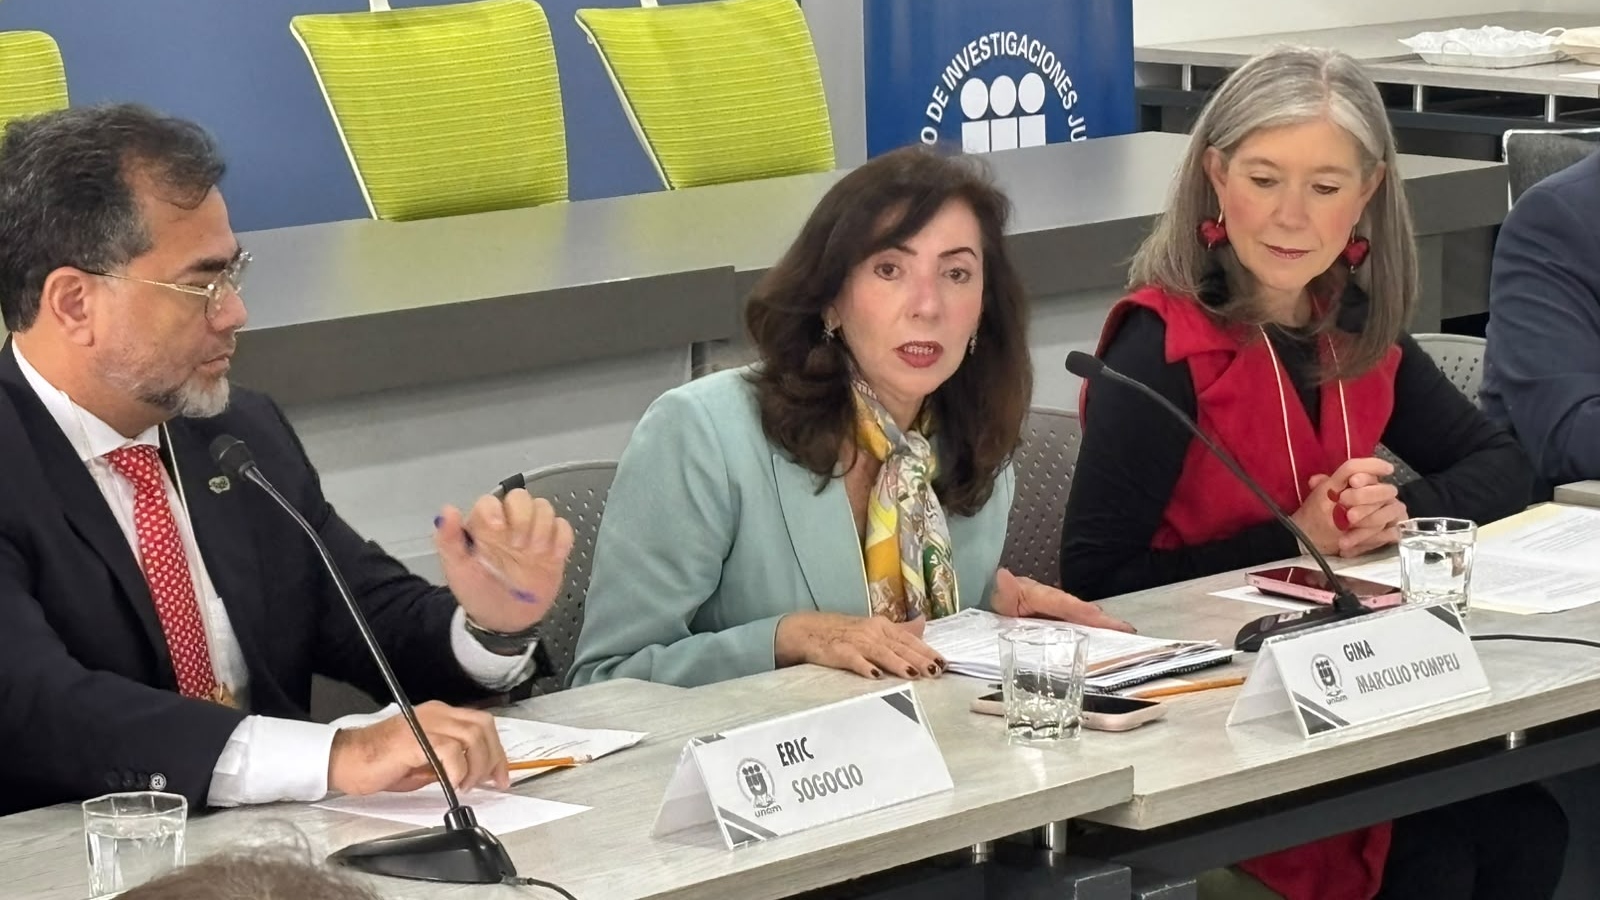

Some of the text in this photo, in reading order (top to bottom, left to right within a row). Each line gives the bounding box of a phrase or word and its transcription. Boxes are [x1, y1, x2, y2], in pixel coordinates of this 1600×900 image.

[926, 85, 949, 123] DE
[942, 31, 1078, 110] INVESTIGACIONES
[1343, 639, 1376, 663] GINA
[1355, 652, 1461, 694] MARCILIO POMPEU
[776, 736, 814, 767] ERIC
[791, 763, 864, 804] SOGOCIO
